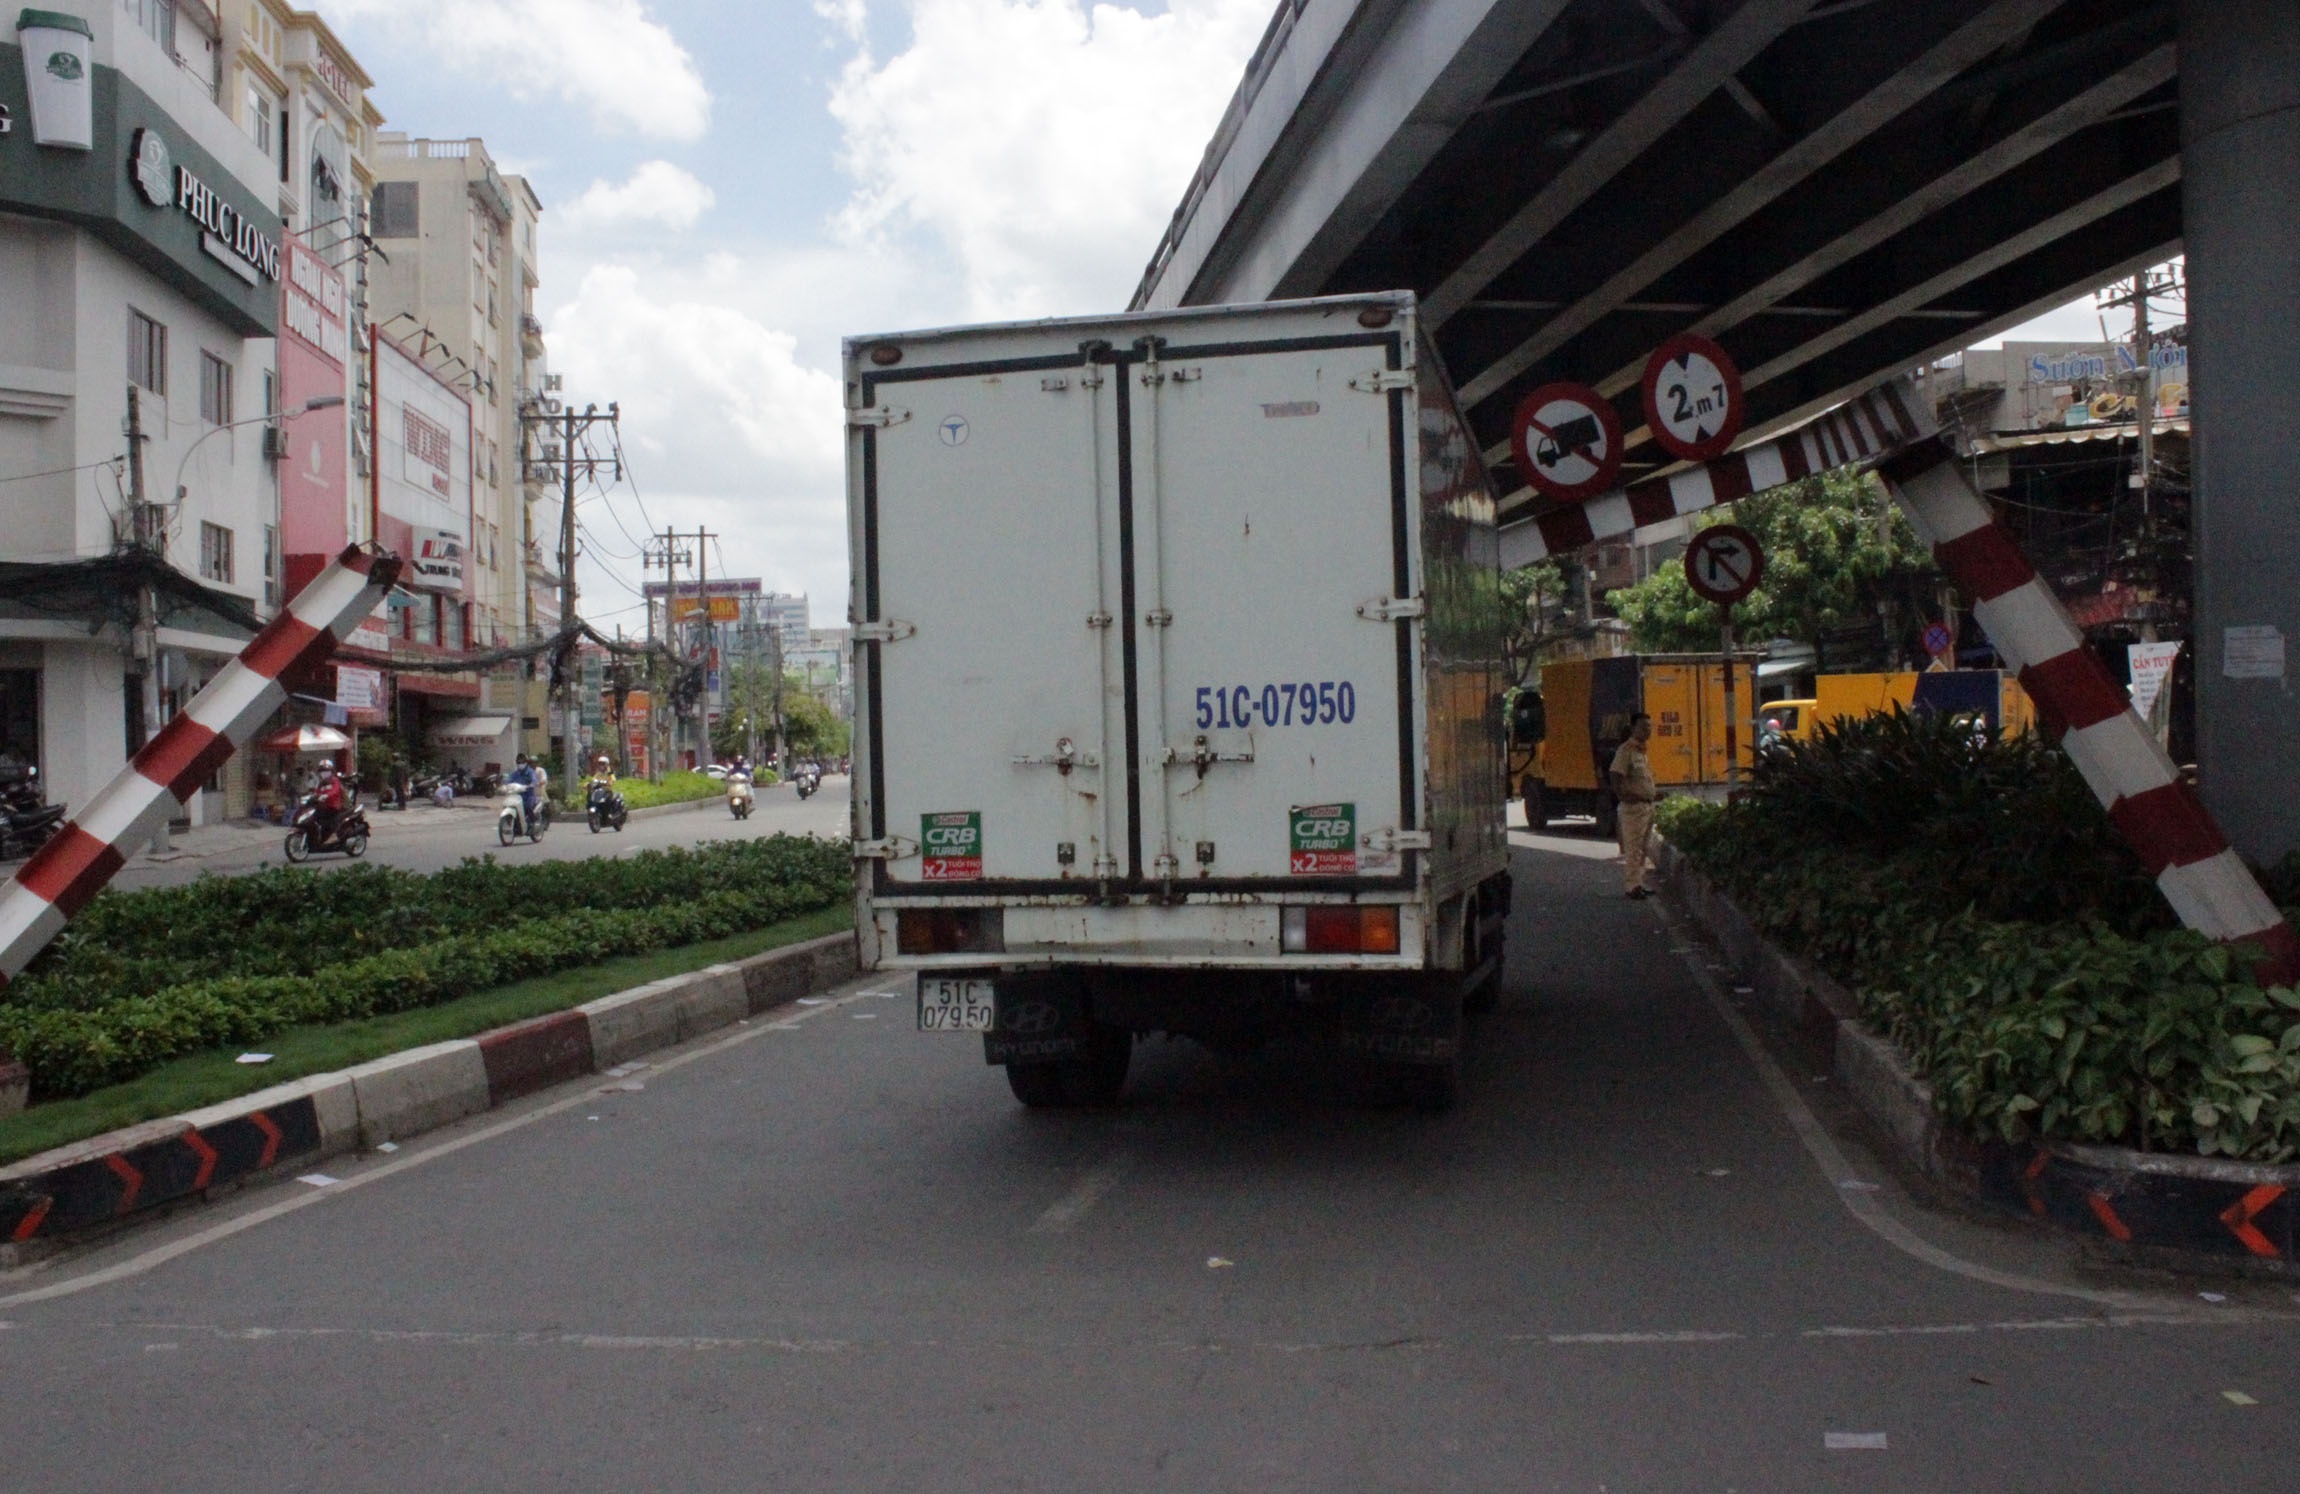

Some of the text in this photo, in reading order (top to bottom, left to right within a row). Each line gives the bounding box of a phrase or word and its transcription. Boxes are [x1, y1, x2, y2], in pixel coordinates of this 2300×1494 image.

[178, 165, 232, 243] PHUC
[235, 213, 281, 281] LONG
[1195, 680, 1356, 730] 51C-07950
[926, 827, 977, 845] CRB
[1295, 820, 1351, 838] CRB
[924, 859, 947, 878] x2
[1292, 852, 1318, 872] x2
[939, 981, 977, 1004] 51C
